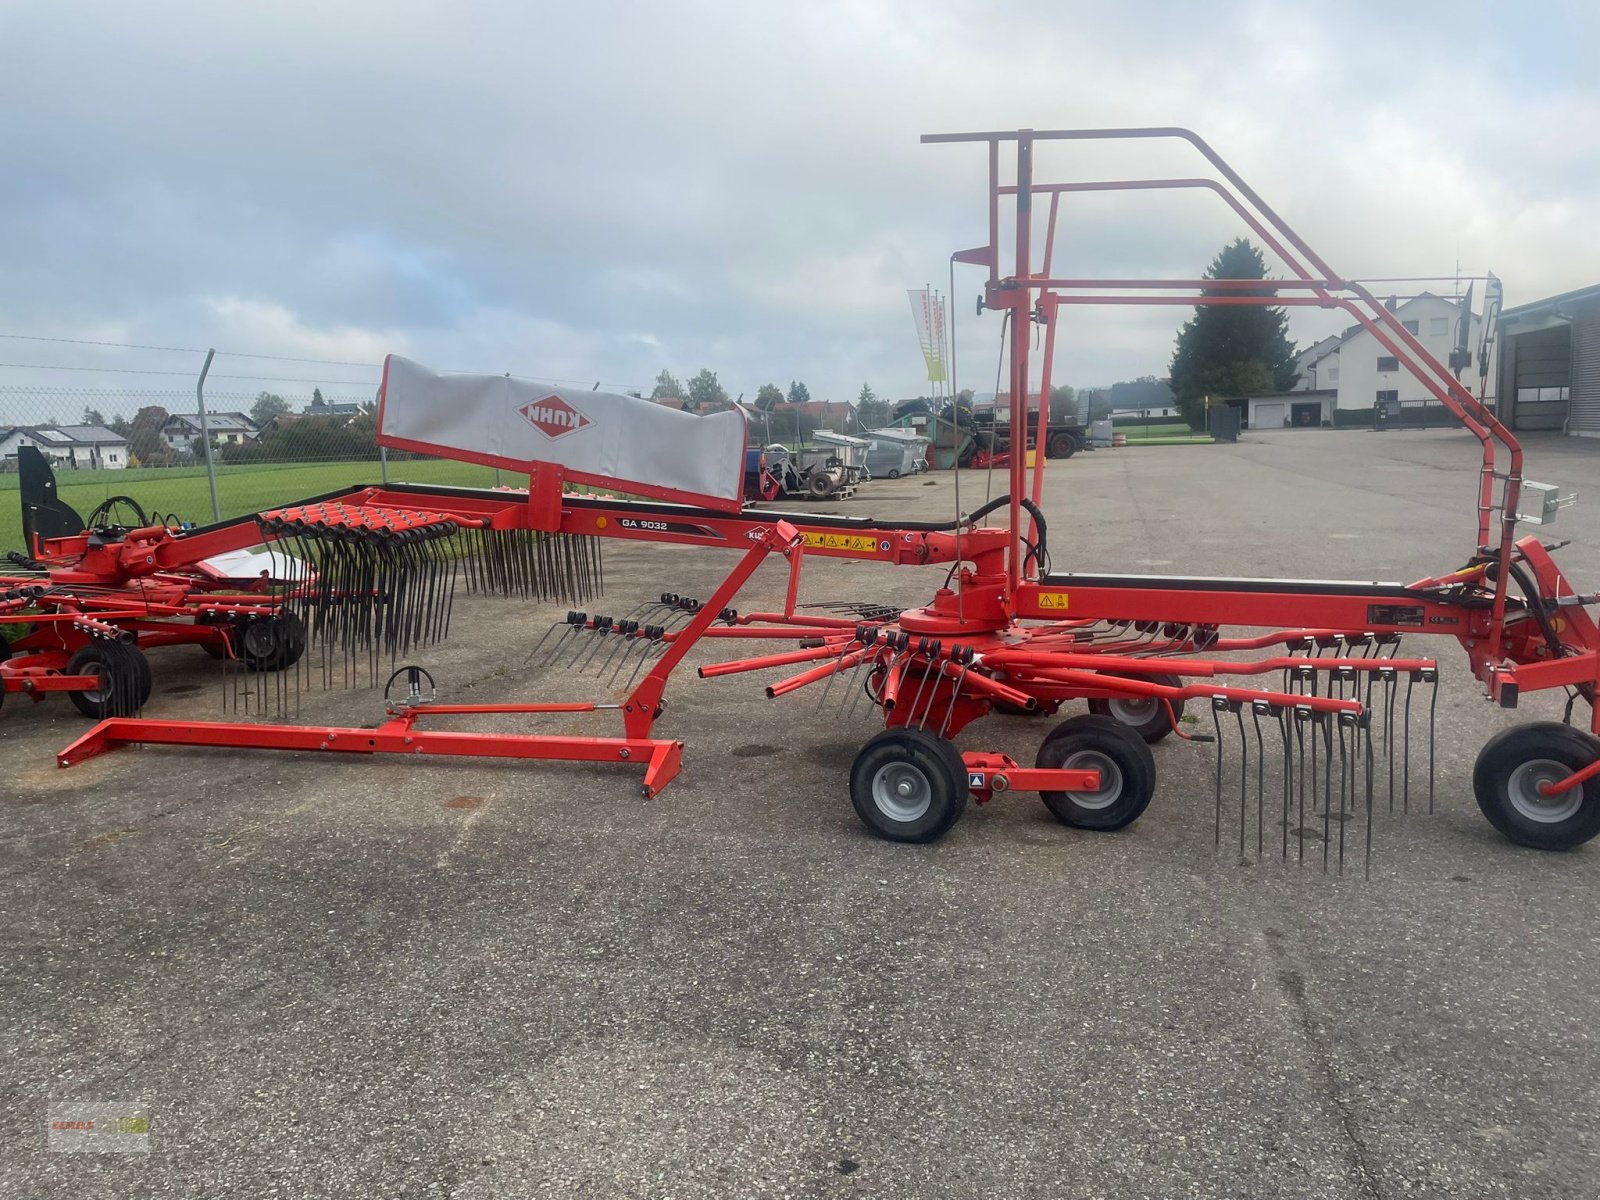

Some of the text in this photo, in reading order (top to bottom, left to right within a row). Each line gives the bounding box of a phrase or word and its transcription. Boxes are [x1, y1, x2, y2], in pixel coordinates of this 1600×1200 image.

[527, 405, 581, 428] KUHN
[622, 519, 668, 530] GA 9032
